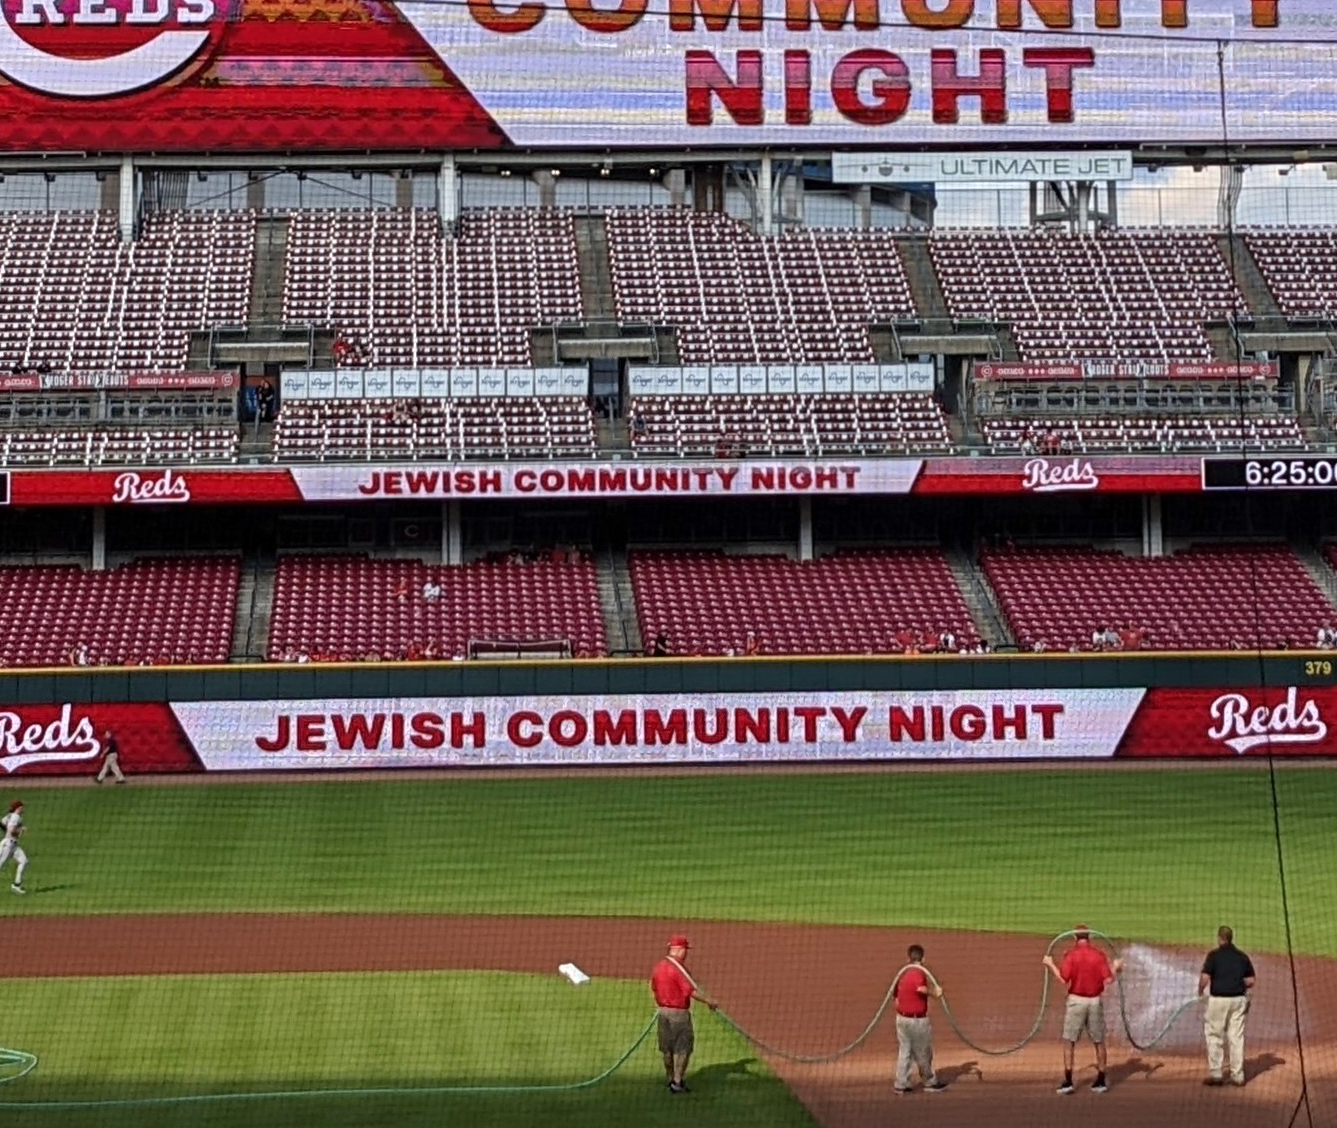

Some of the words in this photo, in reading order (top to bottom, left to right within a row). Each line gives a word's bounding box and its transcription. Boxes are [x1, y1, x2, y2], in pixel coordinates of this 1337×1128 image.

[684, 46, 1096, 126] NIGHT
[939, 157, 1071, 176] ULTIMATE
[1077, 157, 1128, 174] JET
[111, 468, 190, 503] Reds
[358, 469, 502, 495] JEWISH
[513, 466, 739, 494] COMMUNITY
[751, 465, 861, 490] NIGHT
[1021, 458, 1099, 492] Reds
[1305, 660, 1333, 676] 379
[255, 712, 487, 752] JEWISH
[507, 706, 868, 749] COMMUNITY
[888, 703, 1064, 743] NIGHT
[1207, 686, 1328, 755] Reds
